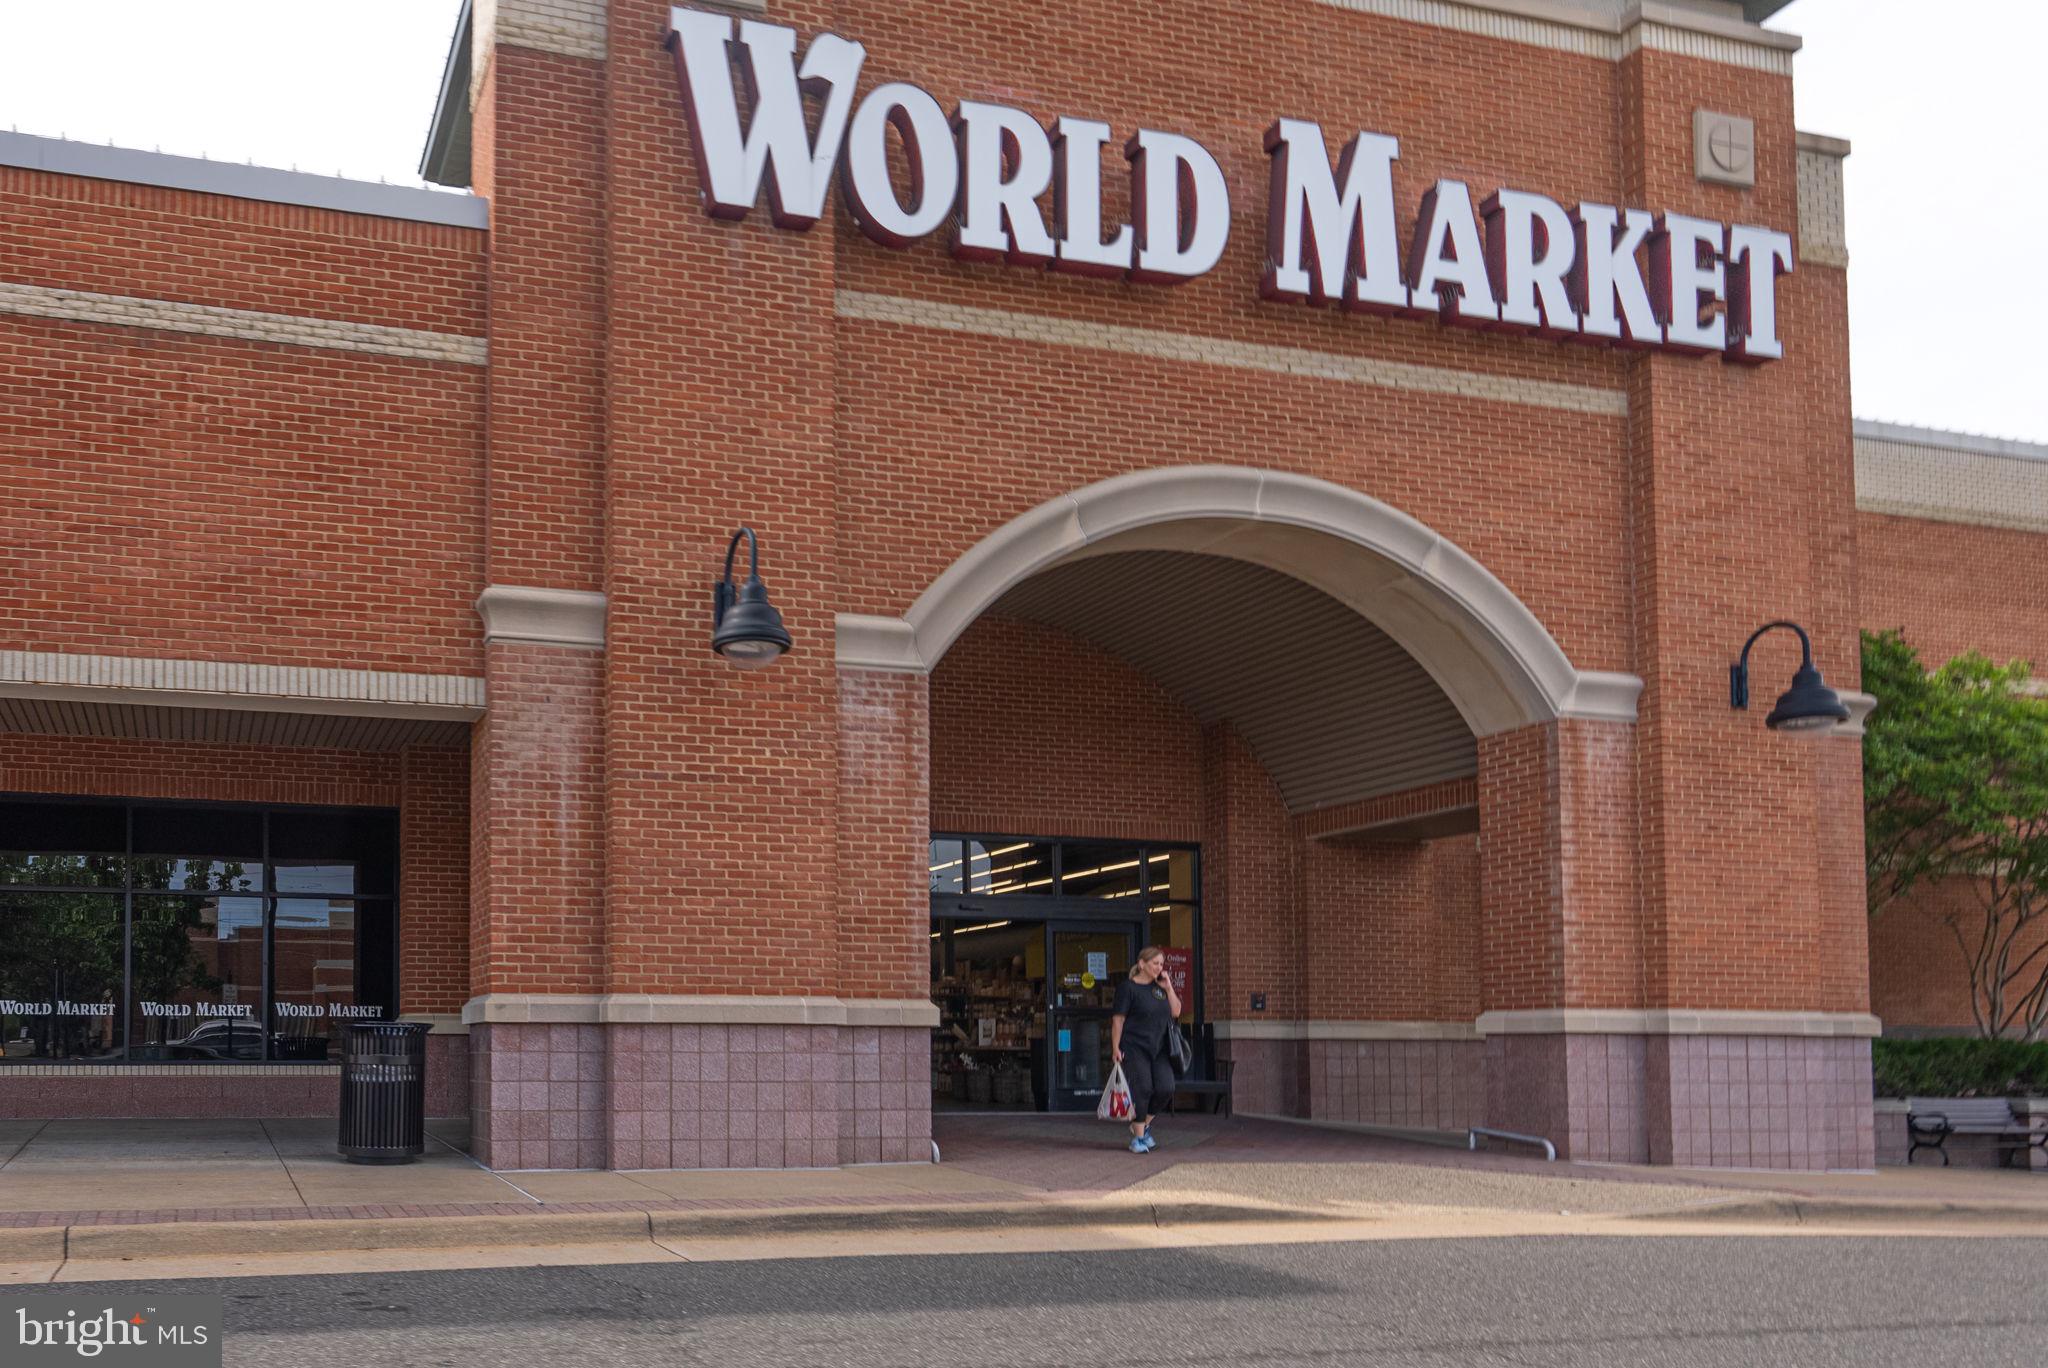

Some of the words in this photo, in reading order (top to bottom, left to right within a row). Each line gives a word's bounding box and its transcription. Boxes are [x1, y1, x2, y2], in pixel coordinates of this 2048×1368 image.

[667, 6, 1231, 277] WORLD
[1270, 118, 1793, 359] MARKET
[0, 1000, 52, 1015] WORLD
[57, 1000, 116, 1016] MARKET
[140, 1001, 191, 1016] WORLD
[195, 1002, 253, 1017] MARKET
[275, 1002, 325, 1017] WORLD
[328, 1003, 384, 1018] MARKET
